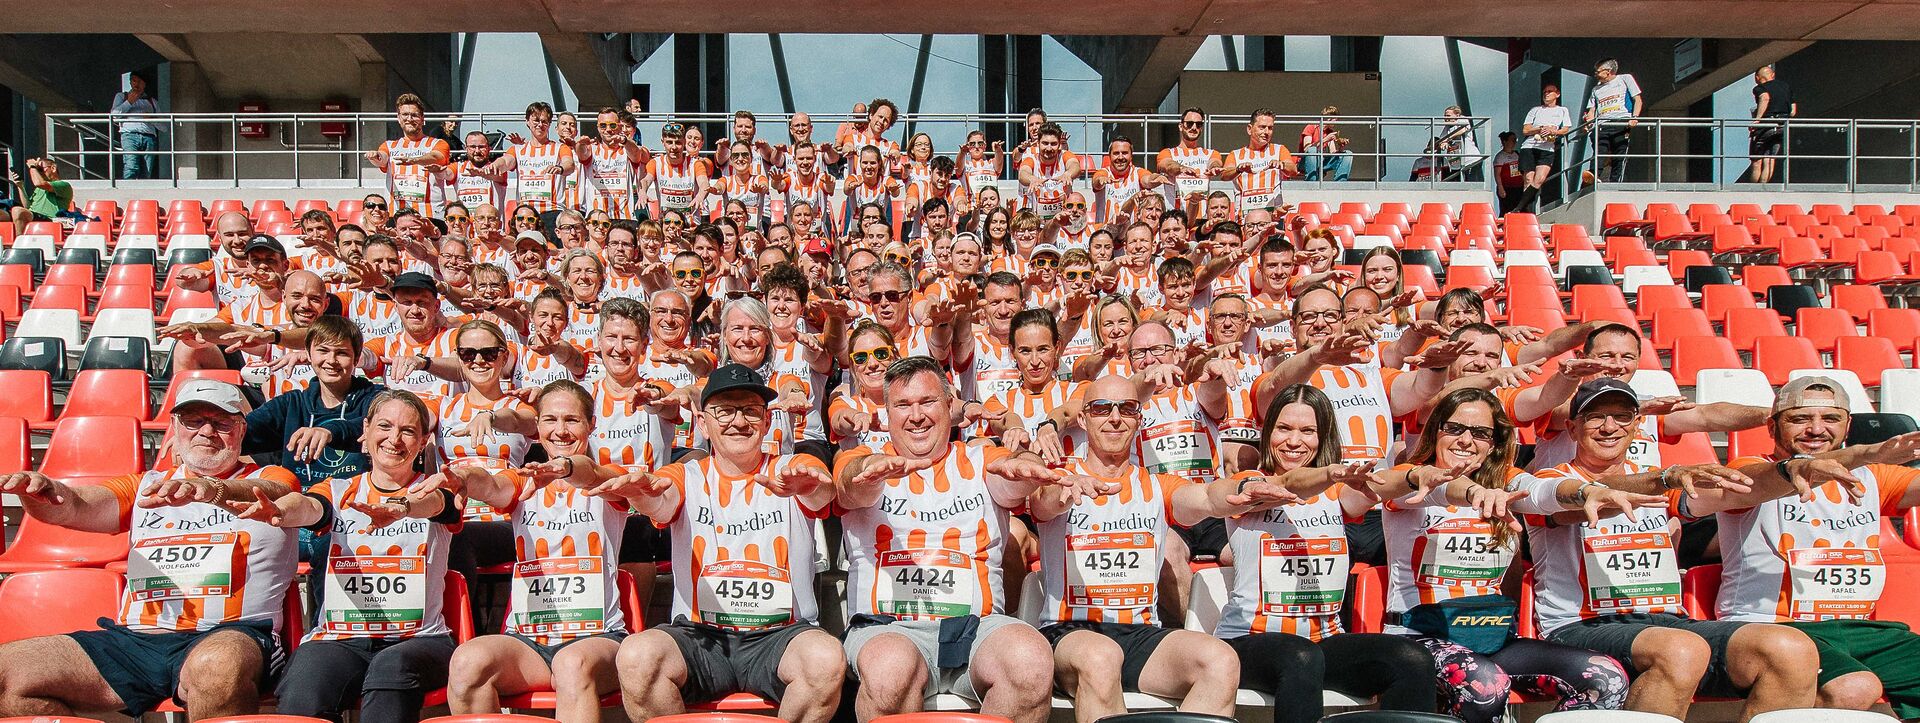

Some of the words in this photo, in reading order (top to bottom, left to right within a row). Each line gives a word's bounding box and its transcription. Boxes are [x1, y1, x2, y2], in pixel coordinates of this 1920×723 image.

[666, 196, 686, 204] 4430
[1246, 194, 1268, 204] 4435
[1156, 434, 1200, 452] 4531
[879, 494, 908, 516] BZ
[920, 492, 986, 522] medien
[178, 508, 238, 531] medie
[332, 516, 356, 535] BZ
[370, 518, 427, 537] medien
[546, 508, 595, 530] mdien
[726, 509, 784, 536] medien
[1066, 508, 1090, 530] BZ
[1262, 508, 1285, 524] BZ
[1293, 508, 1344, 528] medien
[1420, 514, 1445, 530] BZ
[148, 546, 214, 563] 4507
[1084, 551, 1140, 571] 4542
[1606, 551, 1662, 571] 4547
[158, 562, 200, 570] WOLFGANG
[1280, 558, 1336, 577] 4517
[344, 576, 407, 594] 4506
[528, 576, 586, 596] 4473
[896, 568, 956, 588] 4424
[1814, 568, 1872, 586] 4535
[716, 580, 775, 600] 4549
[912, 588, 938, 596] DANIEL
[1143, 585, 1149, 594] D
[364, 596, 387, 604] NADJA
[542, 596, 572, 605] MAREIKE
[1452, 615, 1512, 626] RVRC
